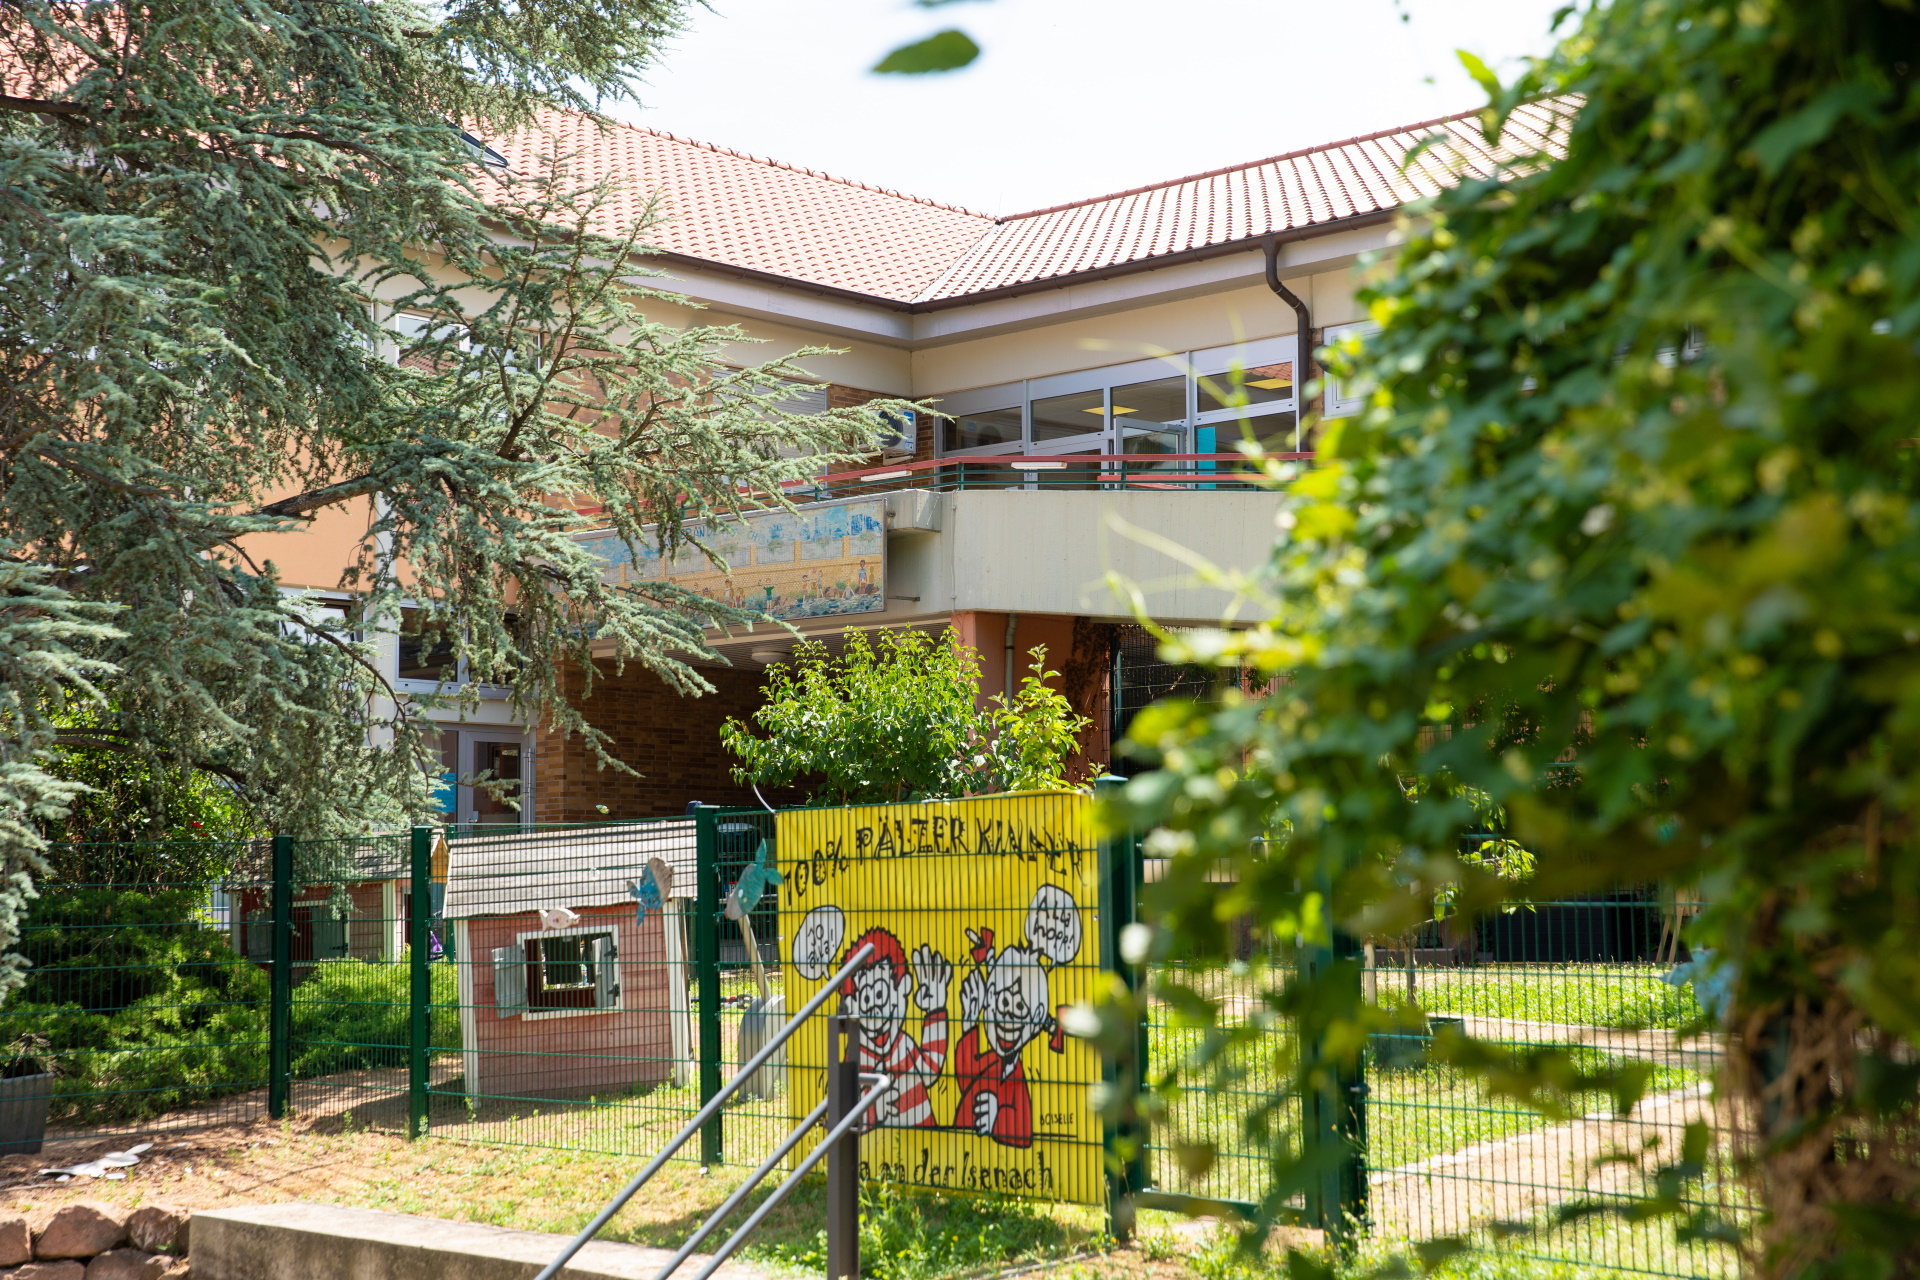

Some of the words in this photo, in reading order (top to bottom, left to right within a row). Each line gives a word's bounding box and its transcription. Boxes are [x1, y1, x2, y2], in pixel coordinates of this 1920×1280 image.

[784, 835, 850, 906] 100%
[856, 815, 971, 865] PÄLZER
[976, 818, 1087, 887] KINDER
[913, 1148, 955, 1187] der
[961, 1151, 1053, 1191] Isenach
